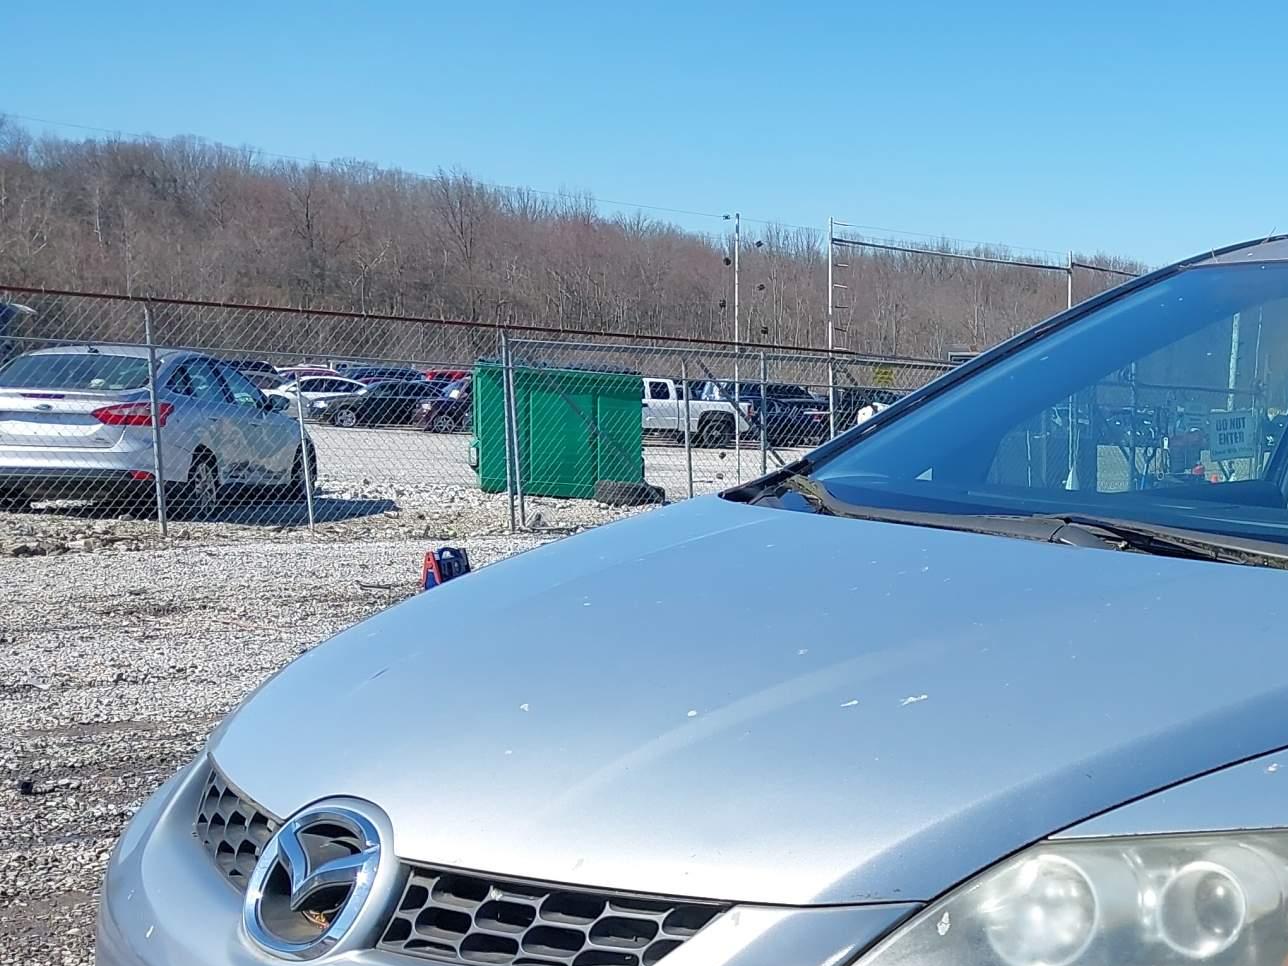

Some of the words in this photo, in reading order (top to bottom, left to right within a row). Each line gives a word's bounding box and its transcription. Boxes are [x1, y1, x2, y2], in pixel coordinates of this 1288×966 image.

[1216, 418, 1228, 431] DO
[1230, 417, 1246, 430] NOT
[1218, 431, 1245, 445] ENTER
